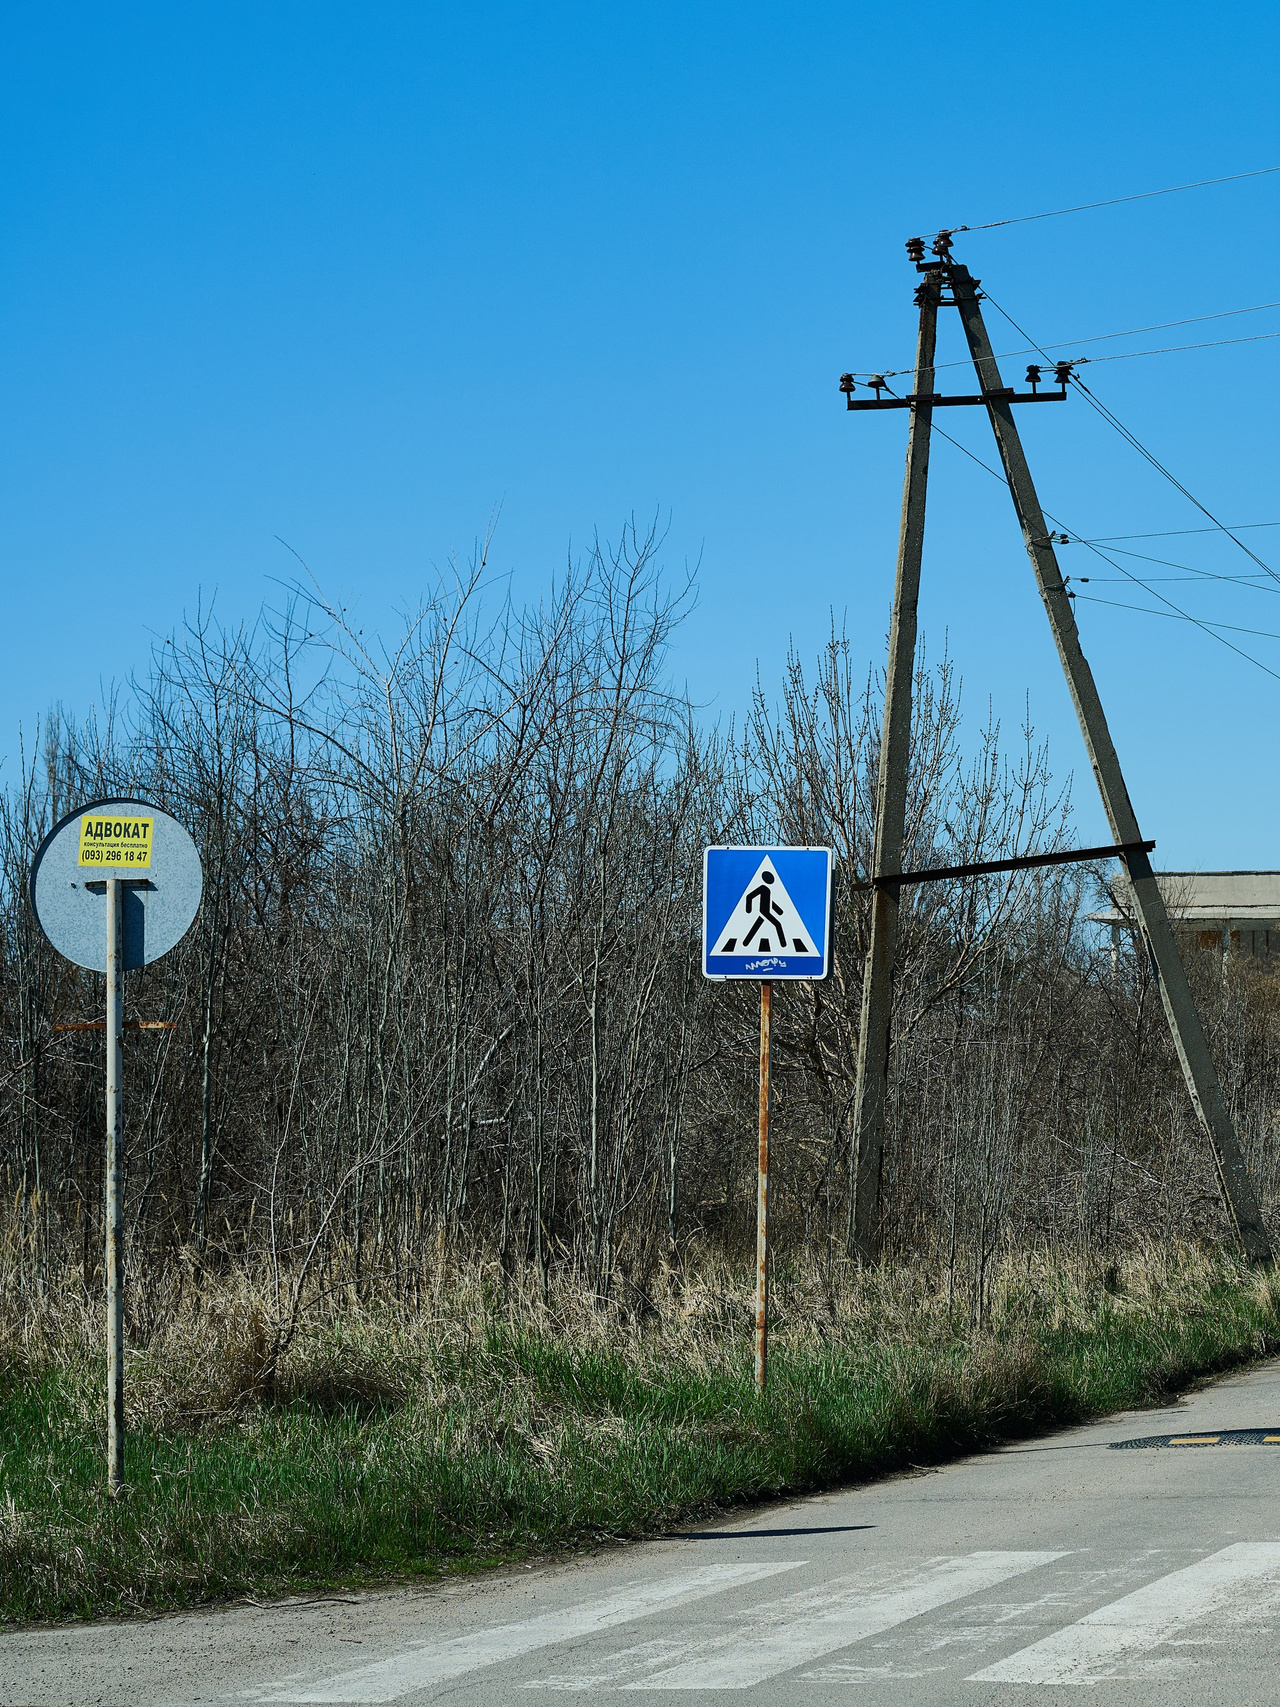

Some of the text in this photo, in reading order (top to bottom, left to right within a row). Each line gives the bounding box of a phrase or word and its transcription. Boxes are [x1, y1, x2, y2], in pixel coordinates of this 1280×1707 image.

[85, 822, 149, 840] АДВОКАТ
[82, 850, 147, 862] (093) 296 18 47
